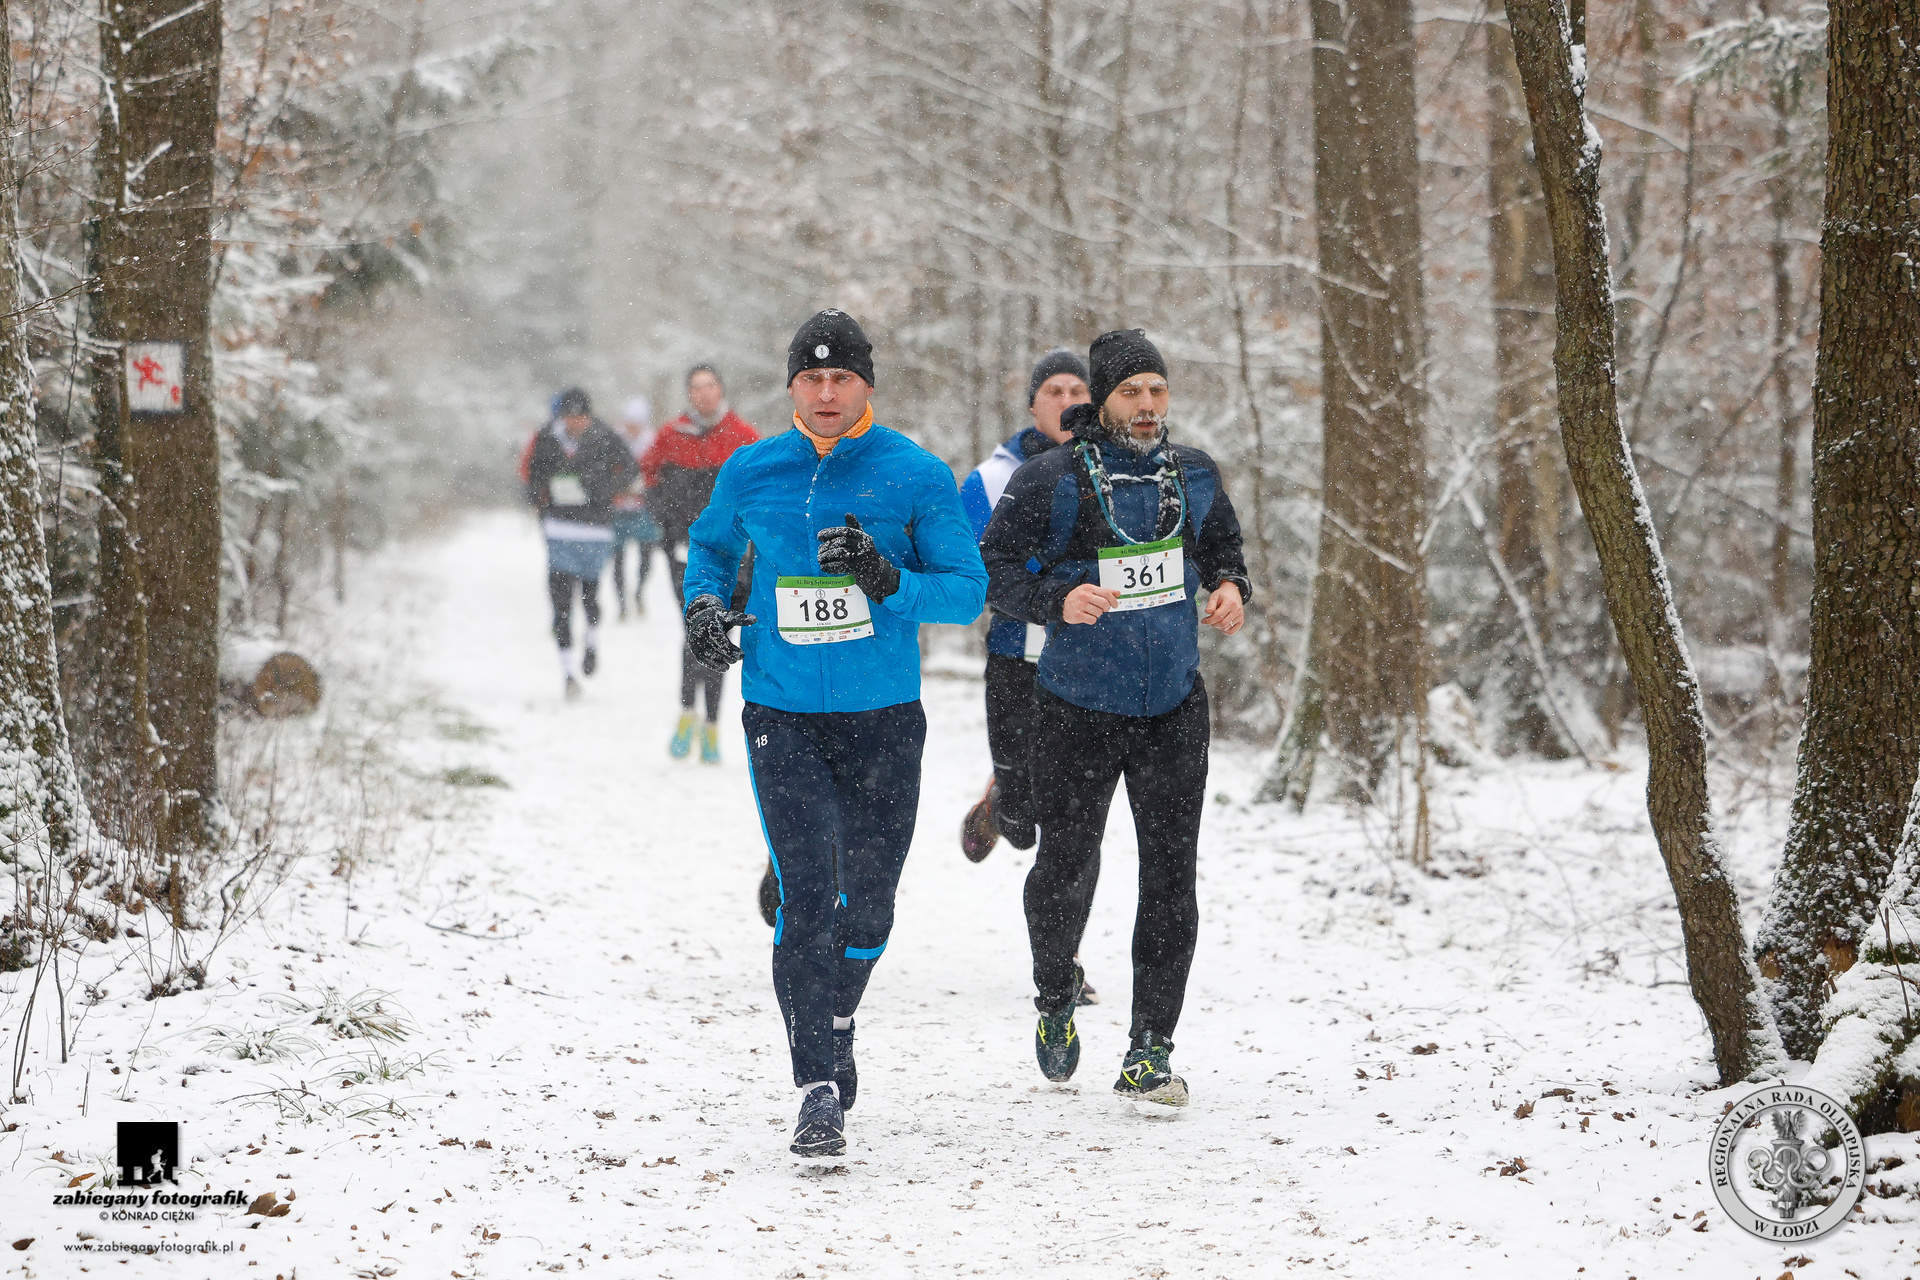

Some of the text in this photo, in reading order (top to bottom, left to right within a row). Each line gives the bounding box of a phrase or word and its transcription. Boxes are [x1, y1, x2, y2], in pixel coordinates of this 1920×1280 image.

[1123, 562, 1164, 589] 361
[799, 598, 848, 622] 188
[755, 734, 768, 748] 18
